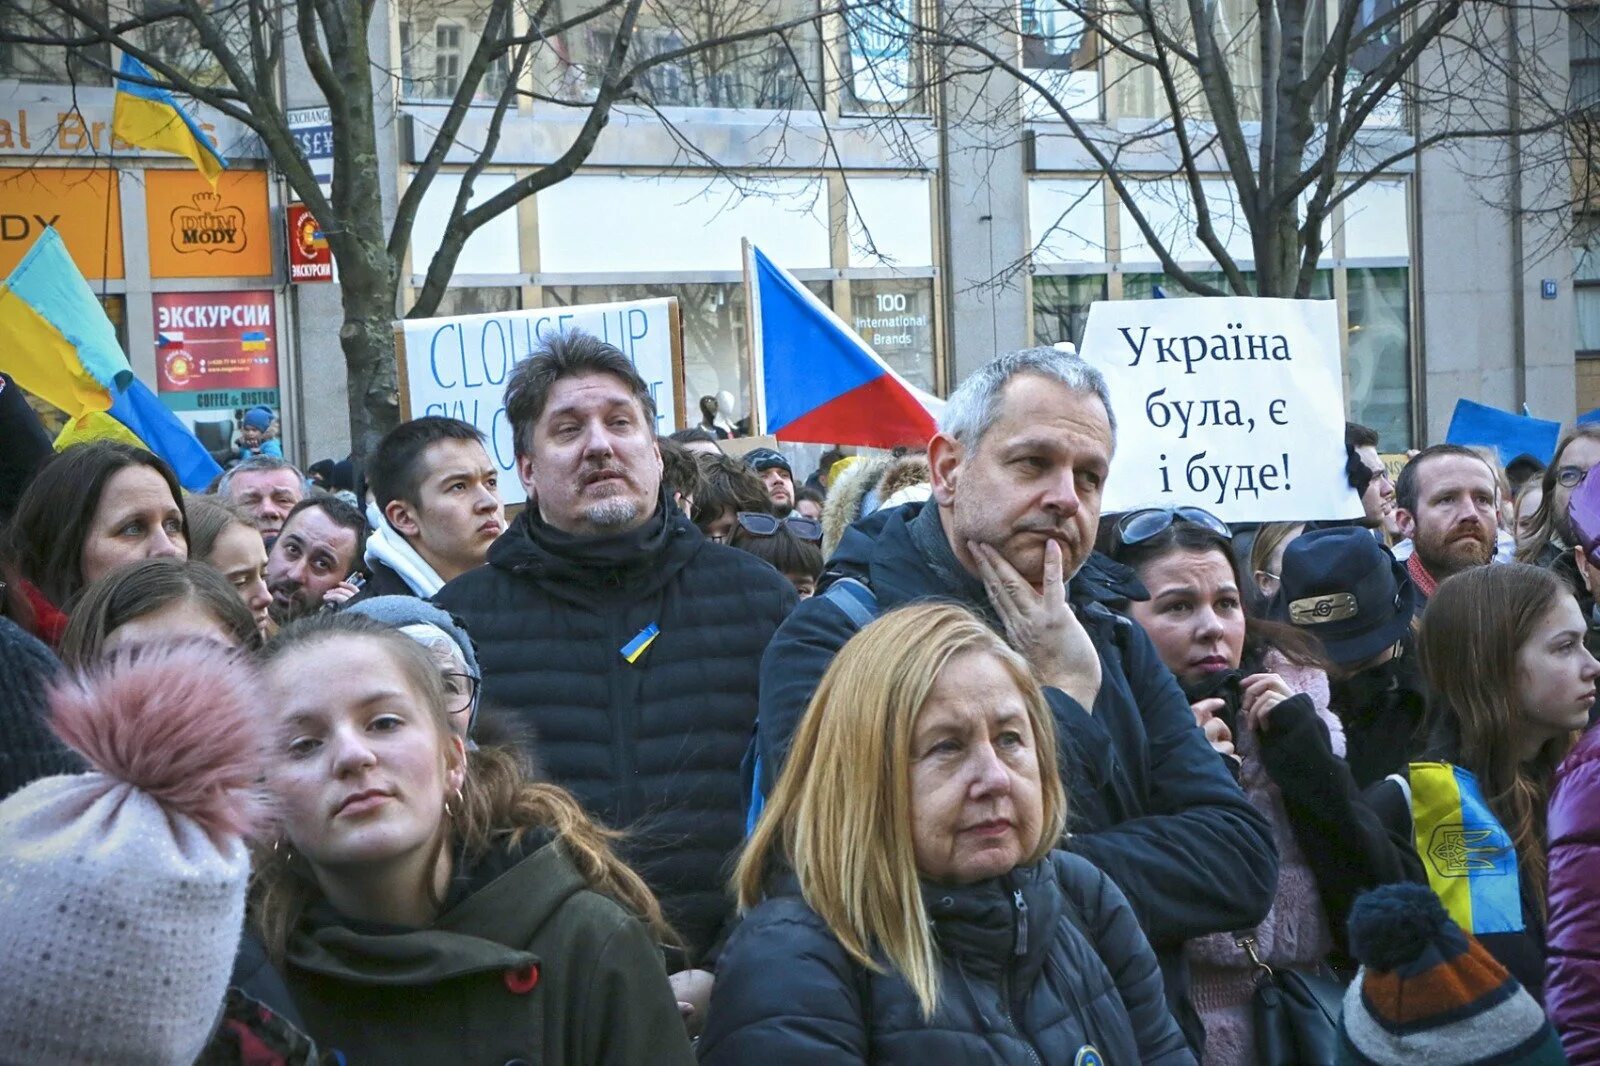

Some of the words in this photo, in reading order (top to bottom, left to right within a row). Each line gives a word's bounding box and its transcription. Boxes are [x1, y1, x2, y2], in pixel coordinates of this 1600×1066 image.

[292, 263, 331, 277] ЭКСКУРСИИ
[876, 294, 906, 312] 100
[158, 304, 271, 328] ЭКСКУРСИИ
[856, 314, 927, 328] International
[873, 333, 912, 345] Brands
[1117, 323, 1292, 374] Україна
[197, 391, 229, 408] COFFEE
[241, 390, 276, 406] BISTRO
[1145, 387, 1255, 439] була,
[1268, 398, 1289, 425] є
[1158, 453, 1173, 493] і
[1186, 450, 1292, 504] буде!
